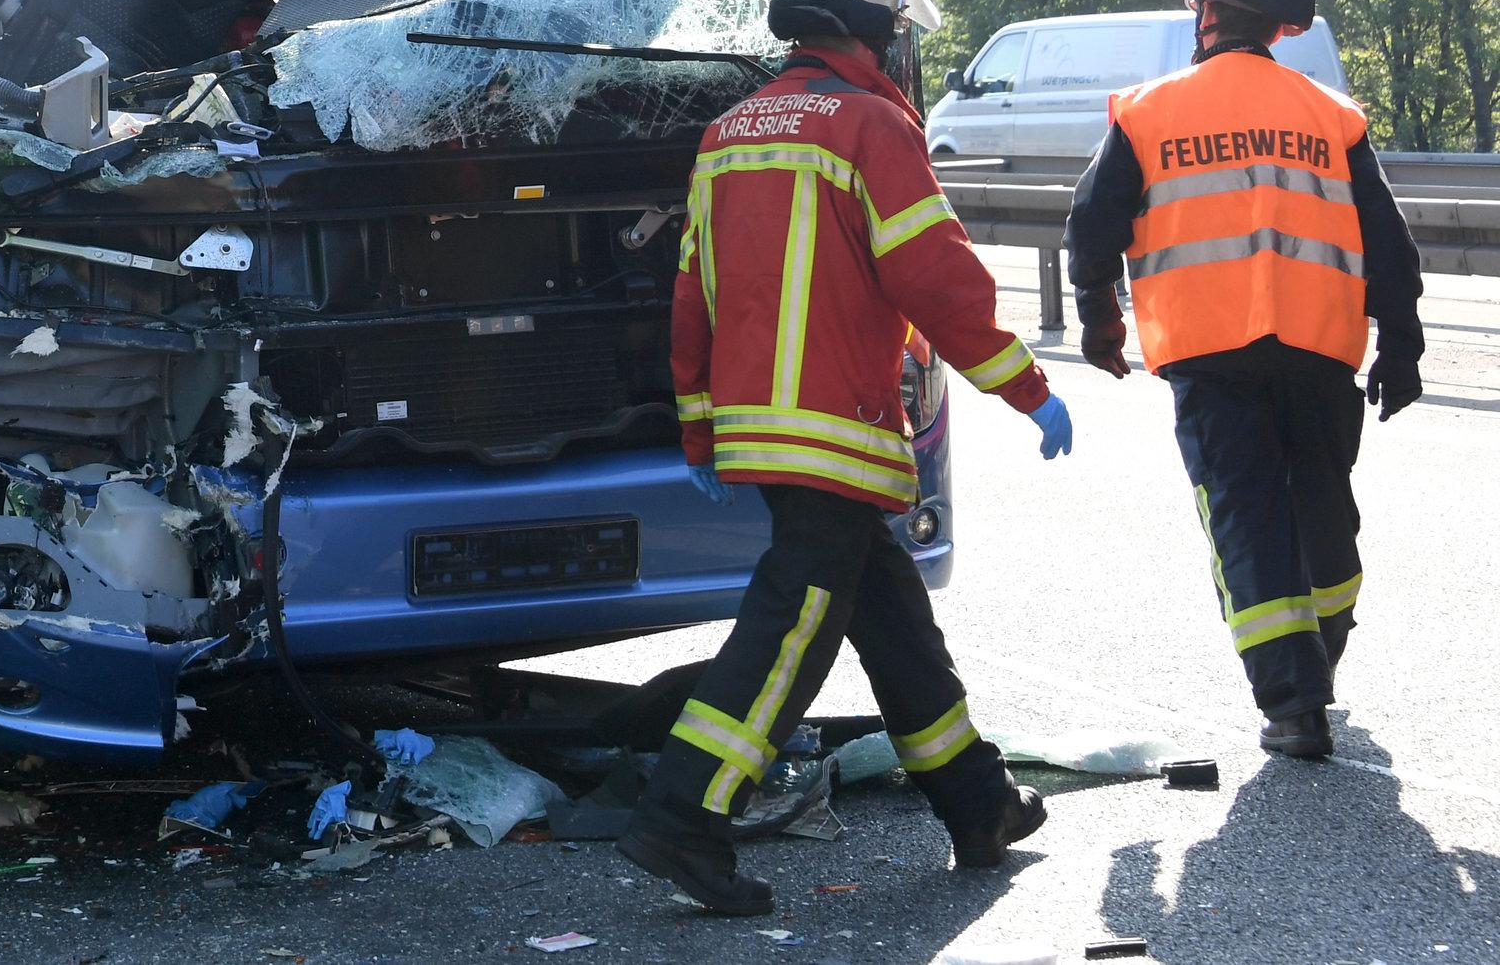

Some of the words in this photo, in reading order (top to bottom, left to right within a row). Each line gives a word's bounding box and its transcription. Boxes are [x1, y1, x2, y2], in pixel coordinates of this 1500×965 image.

[710, 93, 842, 125] FSFEUERWEHR
[717, 113, 804, 142] KARLSRUHE
[1159, 128, 1331, 171] FEUERWEHR
